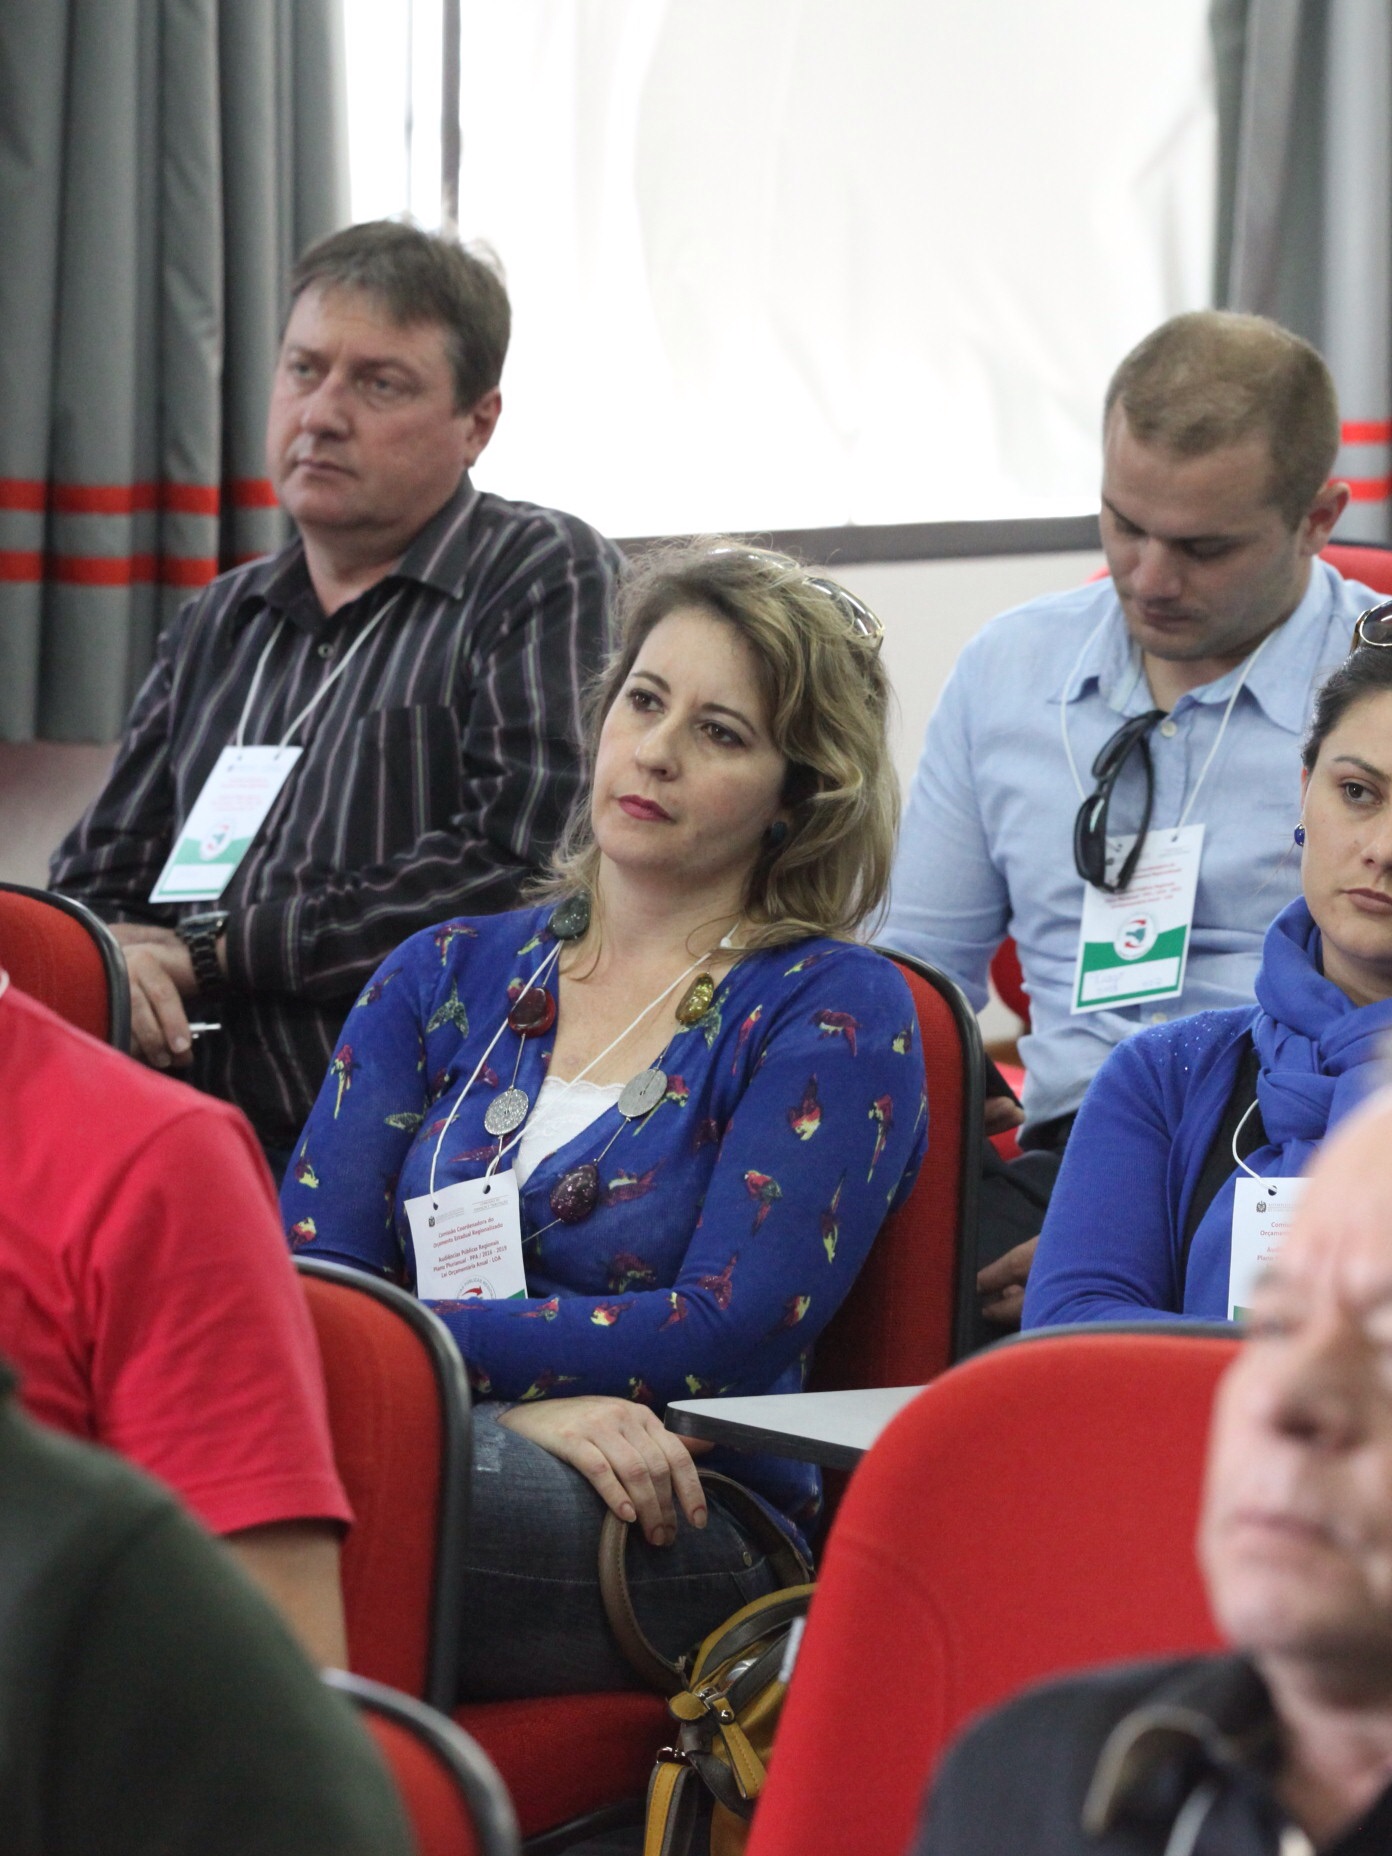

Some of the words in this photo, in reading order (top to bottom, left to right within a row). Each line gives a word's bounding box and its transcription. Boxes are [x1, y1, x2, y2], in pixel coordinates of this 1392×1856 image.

[456, 1219, 487, 1232] Coordenadora
[433, 1238, 453, 1248] Orçamento
[454, 1231, 472, 1242] Estadual
[472, 1223, 503, 1236] Regionalizado
[438, 1251, 461, 1262] Audiências
[461, 1247, 478, 1256] Públicas
[478, 1240, 499, 1250] Regionais
[445, 1258, 467, 1269] Plurianual
[469, 1253, 479, 1261] PPA
[476, 1257, 489, 1267] Anual
[491, 1255, 501, 1263] LOA
